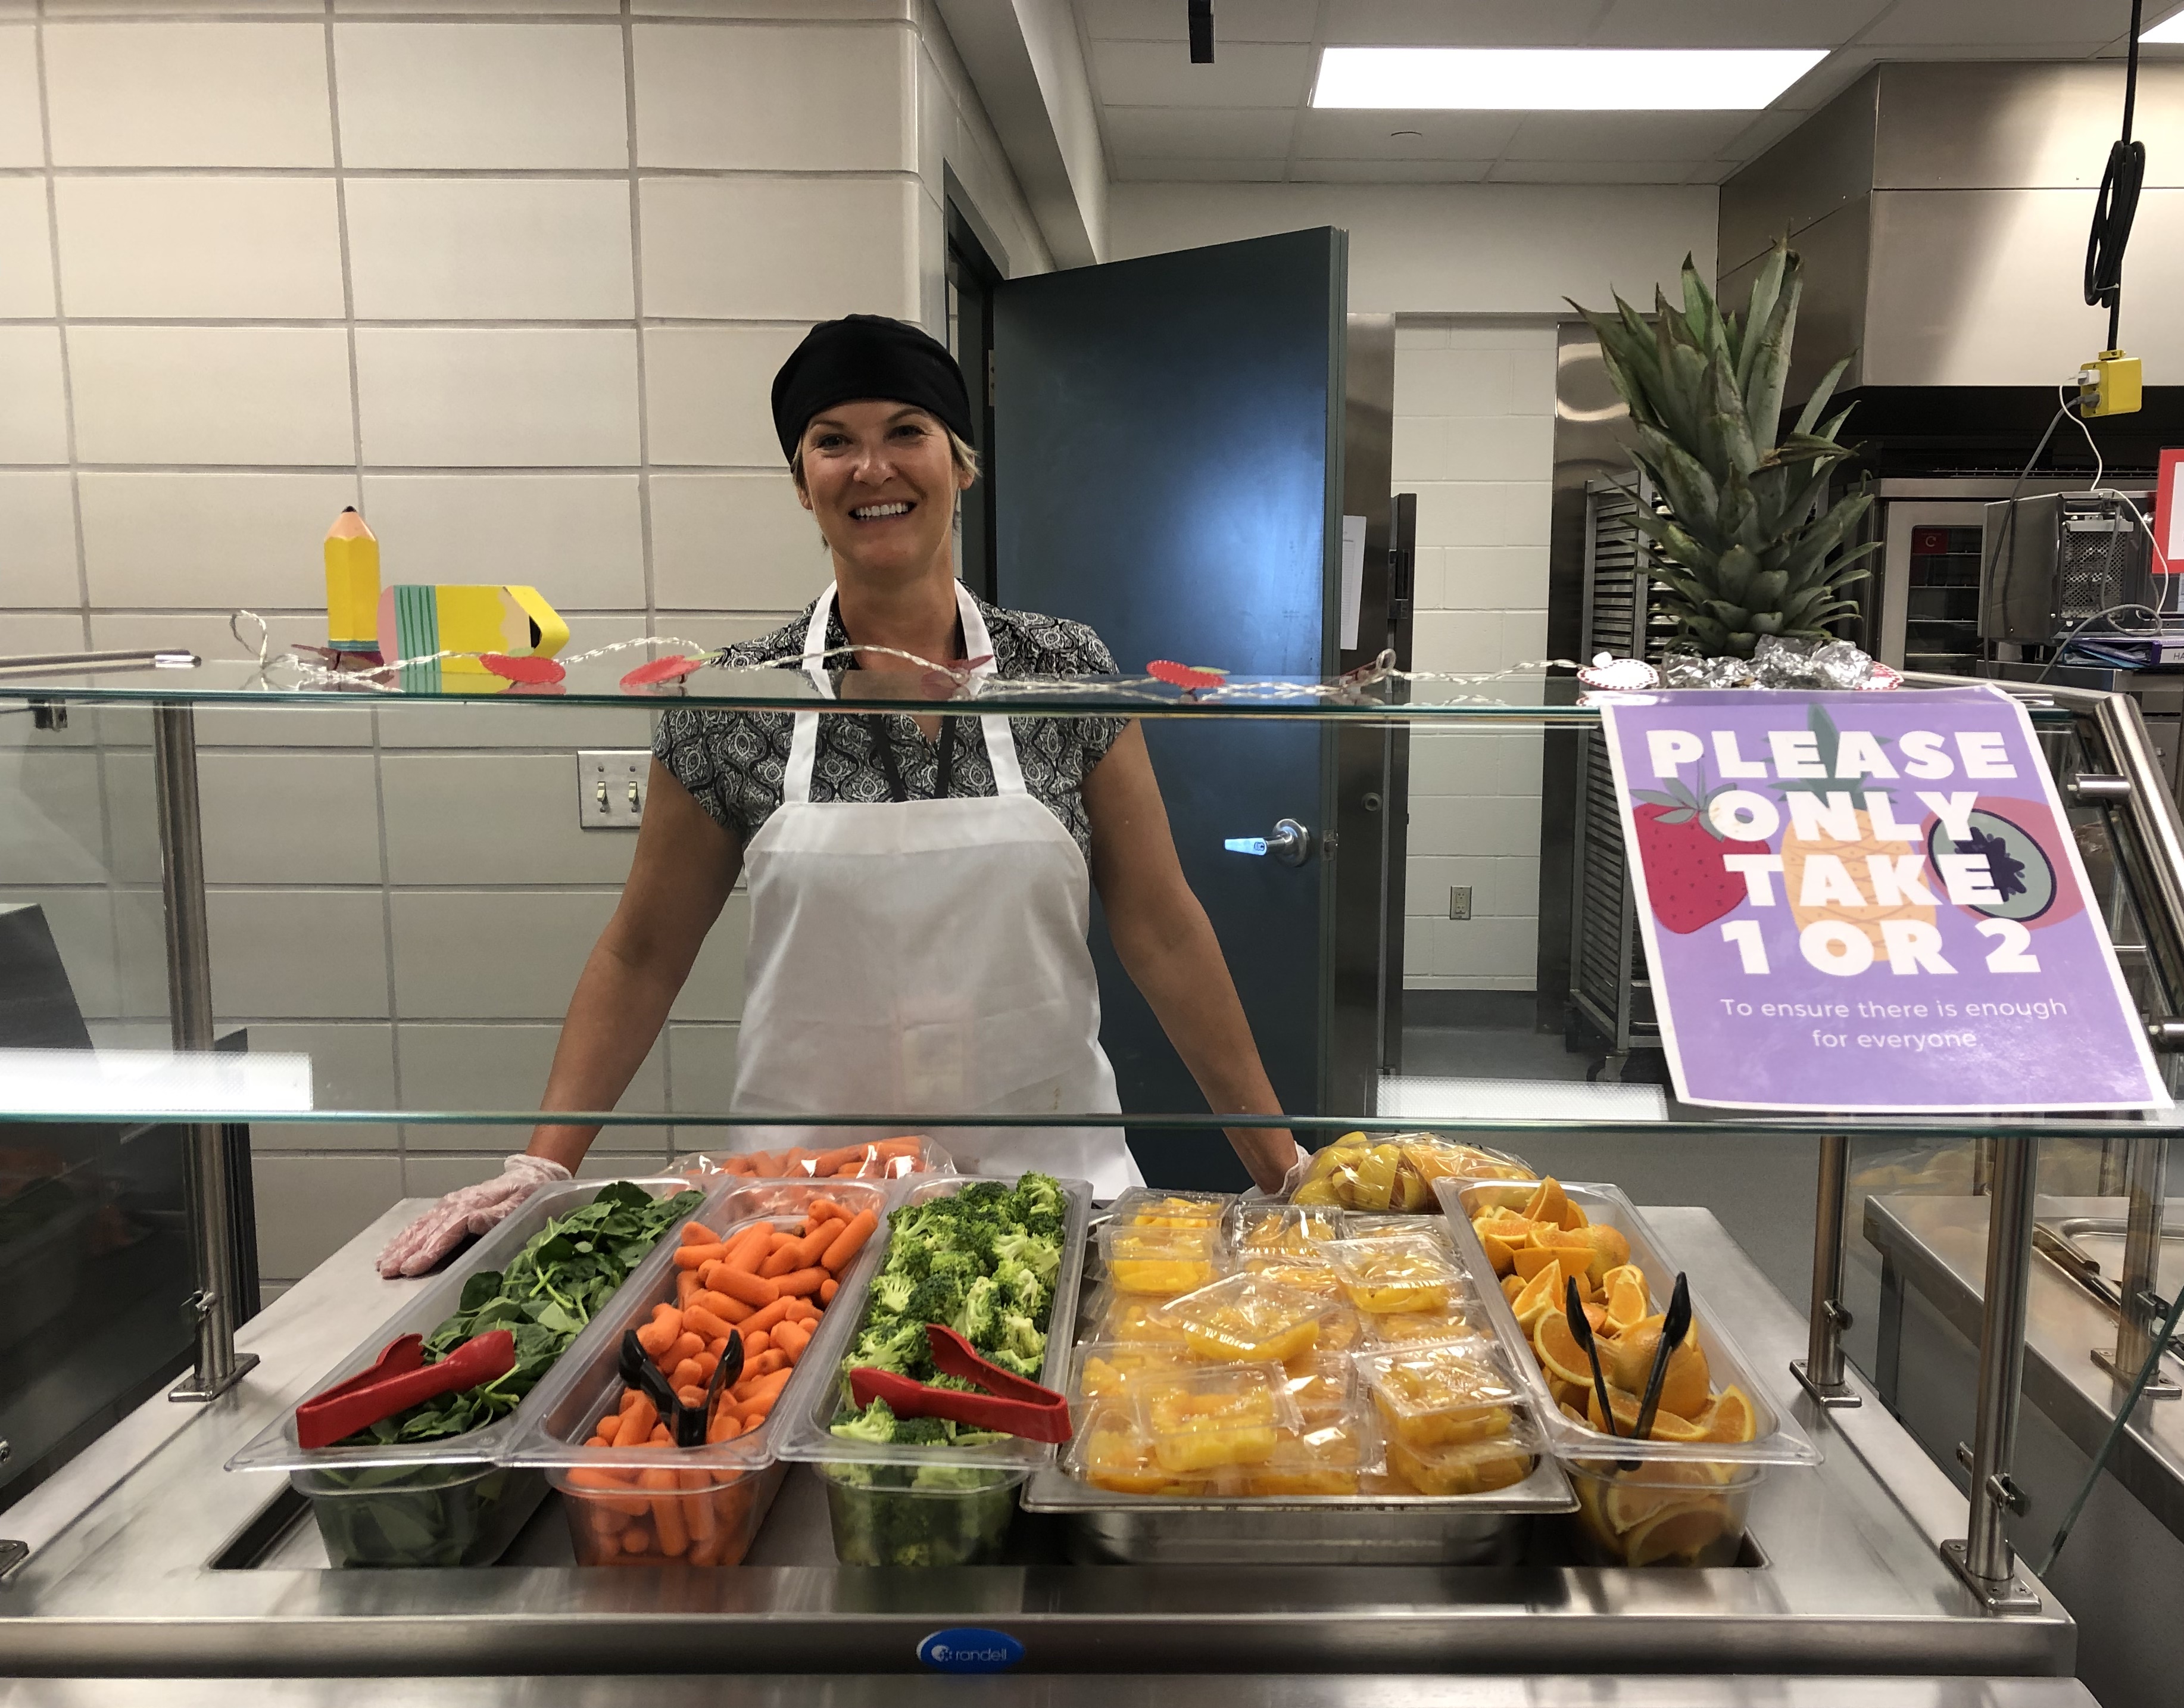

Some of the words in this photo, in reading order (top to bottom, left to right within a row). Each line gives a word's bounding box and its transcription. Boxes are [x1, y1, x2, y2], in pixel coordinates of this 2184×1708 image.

[1646, 730, 2018, 780] PLEASE
[1708, 790, 1979, 842] ONLY
[1724, 853, 2004, 906] TAKE
[1720, 920, 1770, 974] 1
[1799, 919, 1958, 977] OR
[1974, 919, 2041, 973] 2
[1720, 999, 1752, 1018] To
[1761, 1001, 1850, 1018] ensure
[1858, 1001, 1929, 1018] there
[1936, 999, 1958, 1017] is
[1966, 998, 2067, 1020] enough
[1812, 1029, 1848, 1048] for
[1857, 1030, 1977, 1051] everyone
[956, 1648, 1007, 1662] randell
